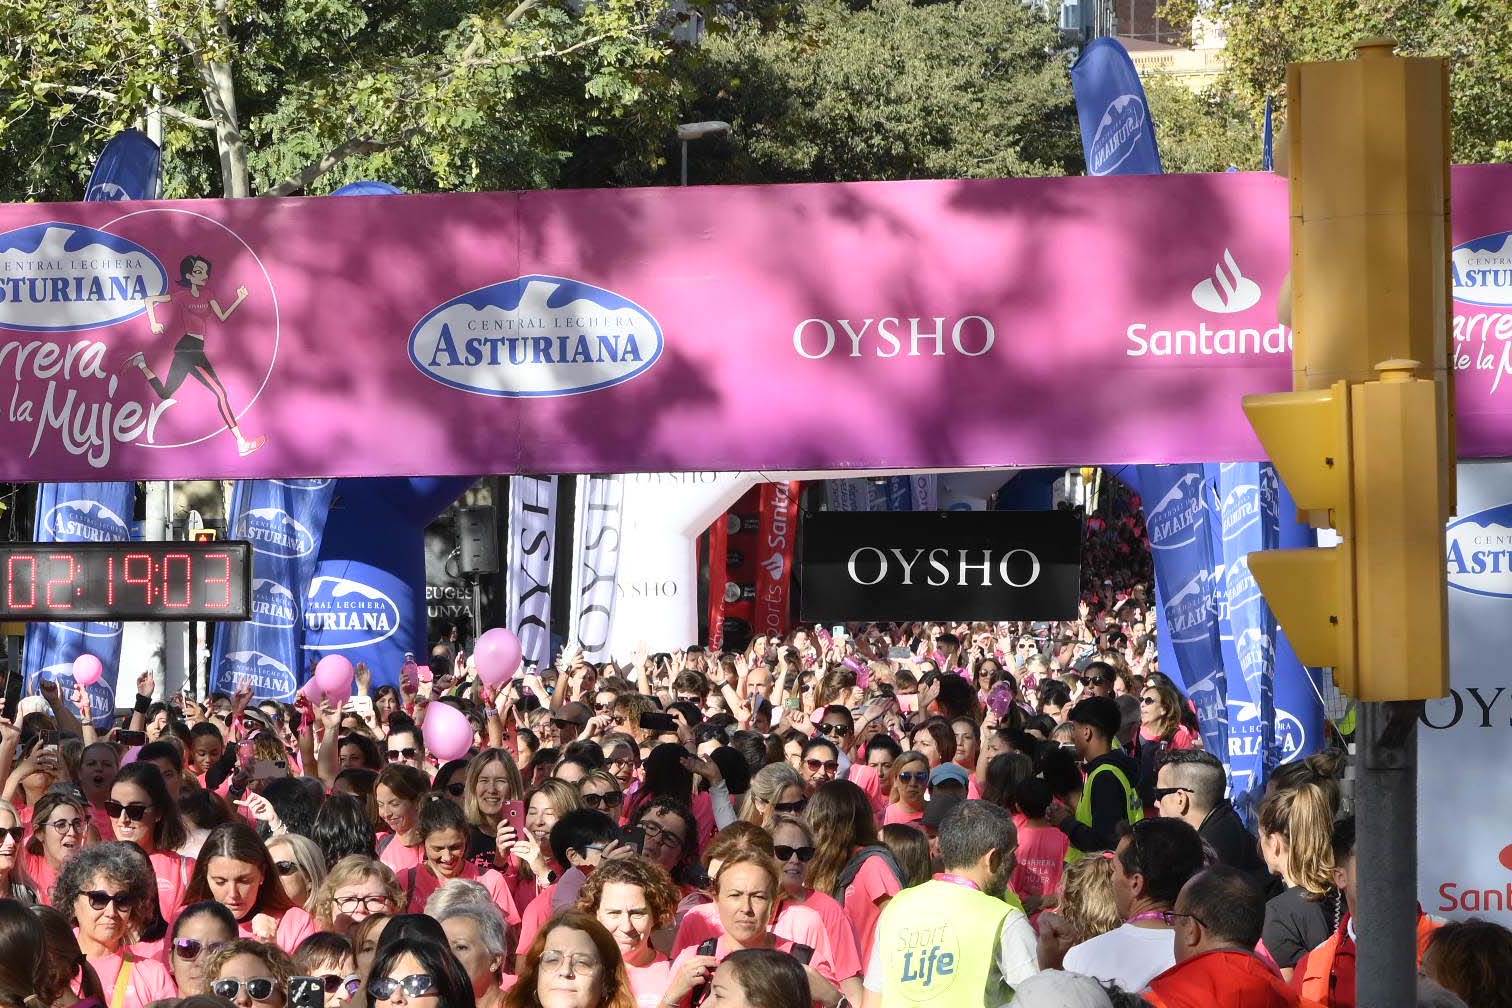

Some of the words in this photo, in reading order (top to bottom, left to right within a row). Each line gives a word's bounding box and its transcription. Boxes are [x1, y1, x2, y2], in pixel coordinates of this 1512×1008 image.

[70, 258, 143, 271] LECHERA
[467, 319, 547, 331] CENTRAL
[553, 316, 636, 329] LECHERA
[792, 315, 996, 359] OYSHO
[1126, 322, 1293, 358] Santand
[428, 322, 644, 368] ASTURIANA
[1477, 343, 1494, 370] la
[9, 383, 34, 423] la
[29, 374, 176, 469] Mujer
[8, 554, 231, 608] 02:19:03
[848, 547, 1040, 588] OYSHO
[426, 586, 472, 600] EUGES
[428, 605, 473, 617] UNYA
[305, 611, 390, 631] TURIANA
[901, 945, 954, 986] Life
